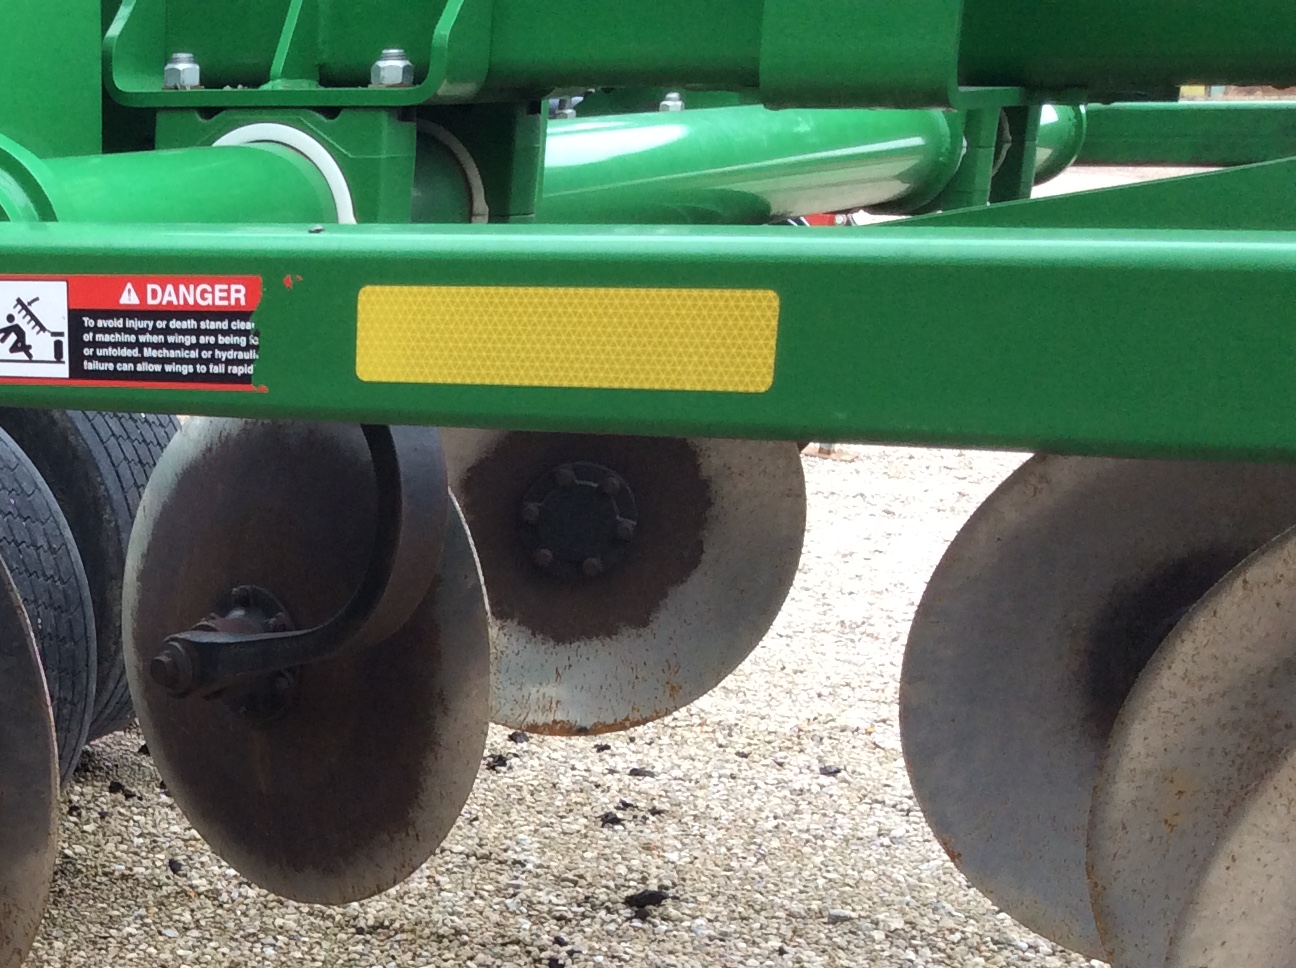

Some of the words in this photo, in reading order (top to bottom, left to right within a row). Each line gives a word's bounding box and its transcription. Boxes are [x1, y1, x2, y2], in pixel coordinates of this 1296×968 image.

[146, 284, 246, 306] DANGER
[82, 316, 95, 328] To
[97, 318, 124, 329] avoid
[125, 318, 154, 331] injury
[156, 320, 166, 329] or
[169, 318, 198, 330] death
[200, 319, 228, 330] stand
[83, 332, 93, 342] of
[95, 332, 136, 343] machine
[138, 333, 164, 343] when
[166, 333, 196, 346] wings
[199, 335, 215, 345] are
[217, 334, 246, 347] being
[83, 347, 94, 356] or
[96, 346, 141, 357] unfolded.
[143, 347, 199, 358] Mechanical
[201, 350, 212, 359] or
[83, 360, 114, 371] failure
[116, 362, 134, 371] can
[136, 361, 162, 372] allow
[164, 362, 194, 375] wings
[196, 363, 207, 374] to
[209, 363, 225, 374] fall
[227, 363, 253, 377] rapid
